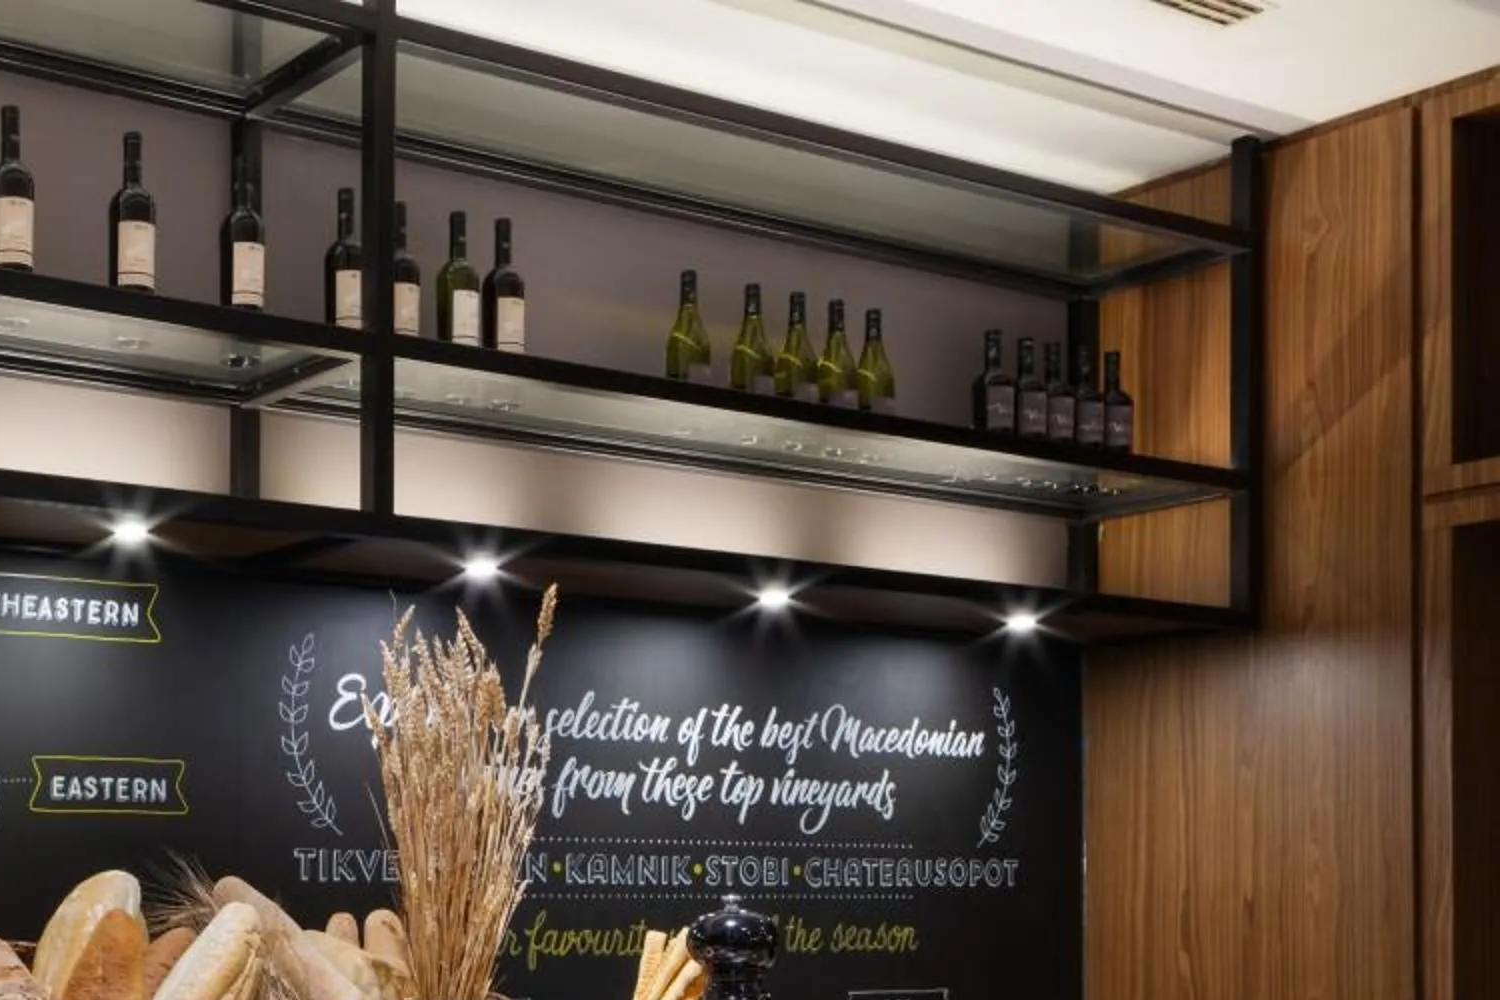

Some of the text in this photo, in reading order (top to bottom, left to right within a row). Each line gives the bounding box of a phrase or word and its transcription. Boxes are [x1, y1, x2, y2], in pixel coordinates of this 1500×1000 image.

[538, 690, 671, 750] selection
[677, 707, 708, 767] of
[711, 703, 755, 752] the
[760, 706, 818, 765] best
[820, 703, 986, 759] Macedonian
[51, 775, 167, 803] EASTERN
[552, 756, 637, 819] from
[639, 757, 715, 821] these
[720, 760, 765, 825] top
[769, 768, 898, 836] vineyards
[294, 848, 401, 883] TIKVE
[565, 853, 693, 886] KAMNIK
[705, 854, 790, 888] STOBI
[525, 908, 646, 971] favourit
[784, 914, 825, 953] the
[830, 919, 920, 954] season
